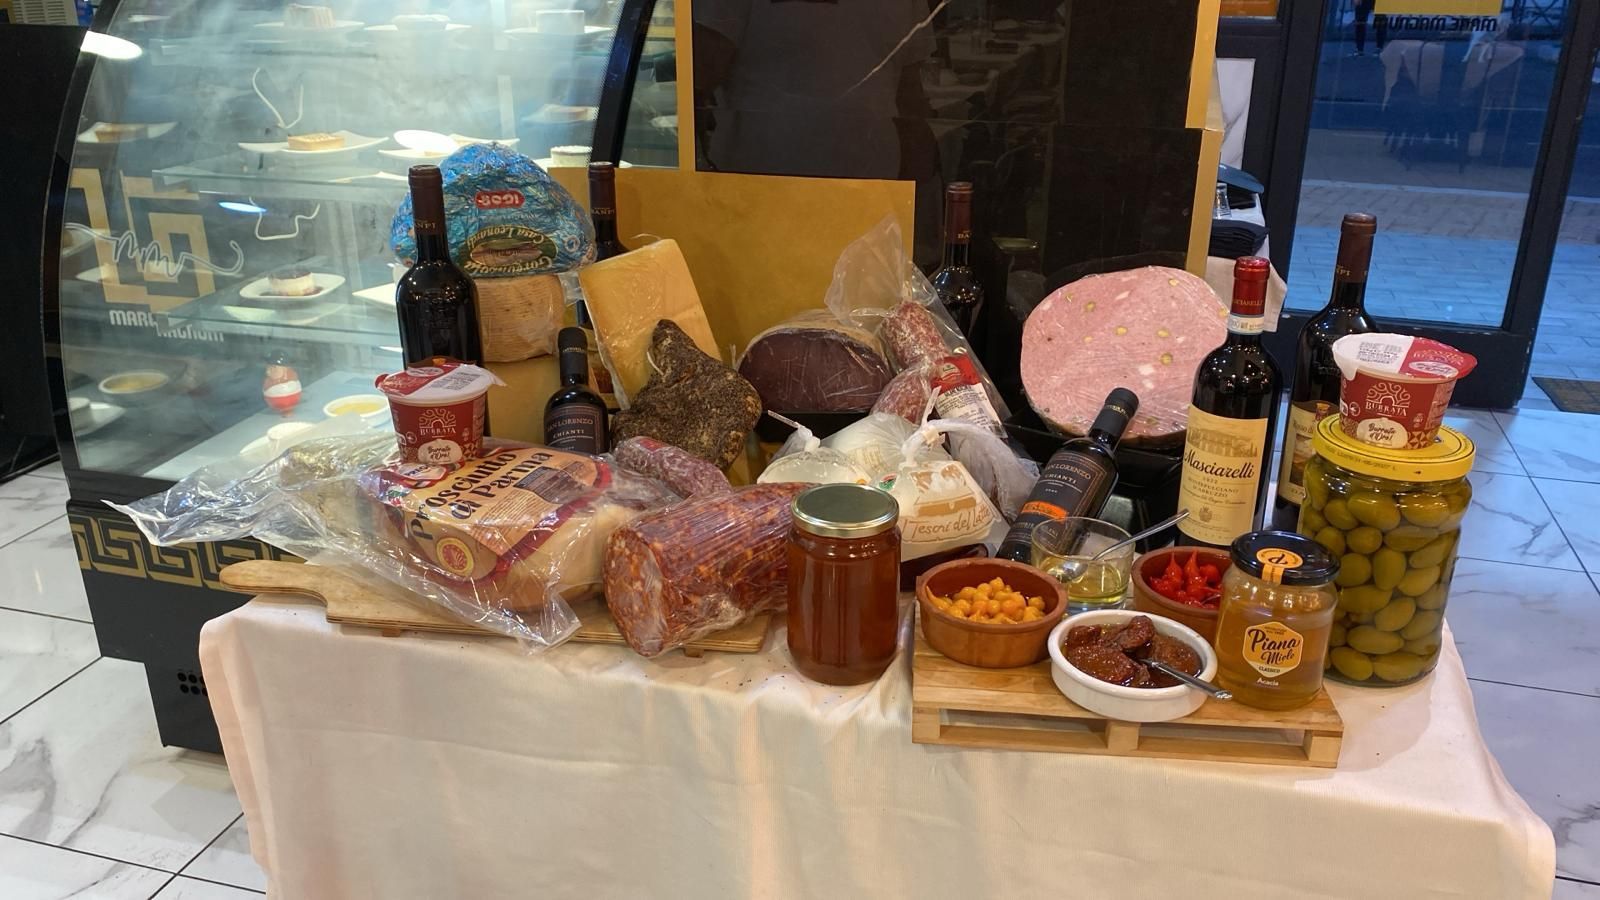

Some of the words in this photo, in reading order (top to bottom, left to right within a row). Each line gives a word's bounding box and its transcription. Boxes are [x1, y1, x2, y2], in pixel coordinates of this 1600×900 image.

[516, 229, 545, 245] Casa
[1365, 401, 1407, 417] BURRATA
[559, 417, 594, 427] LORENZO
[420, 428, 457, 436] BURRATA
[553, 429, 585, 439] CHIANTI
[1055, 463, 1091, 479] LORENZO
[1184, 449, 1254, 479] Masciarelli
[448, 498, 483, 519] di
[469, 451, 555, 498] Parma
[1045, 474, 1076, 484] CHIANTI
[410, 453, 517, 541] Prosciutto
[909, 520, 950, 539] Tesori
[953, 511, 971, 531] del
[1247, 629, 1300, 653] Piana
[1260, 649, 1295, 665] Miele
